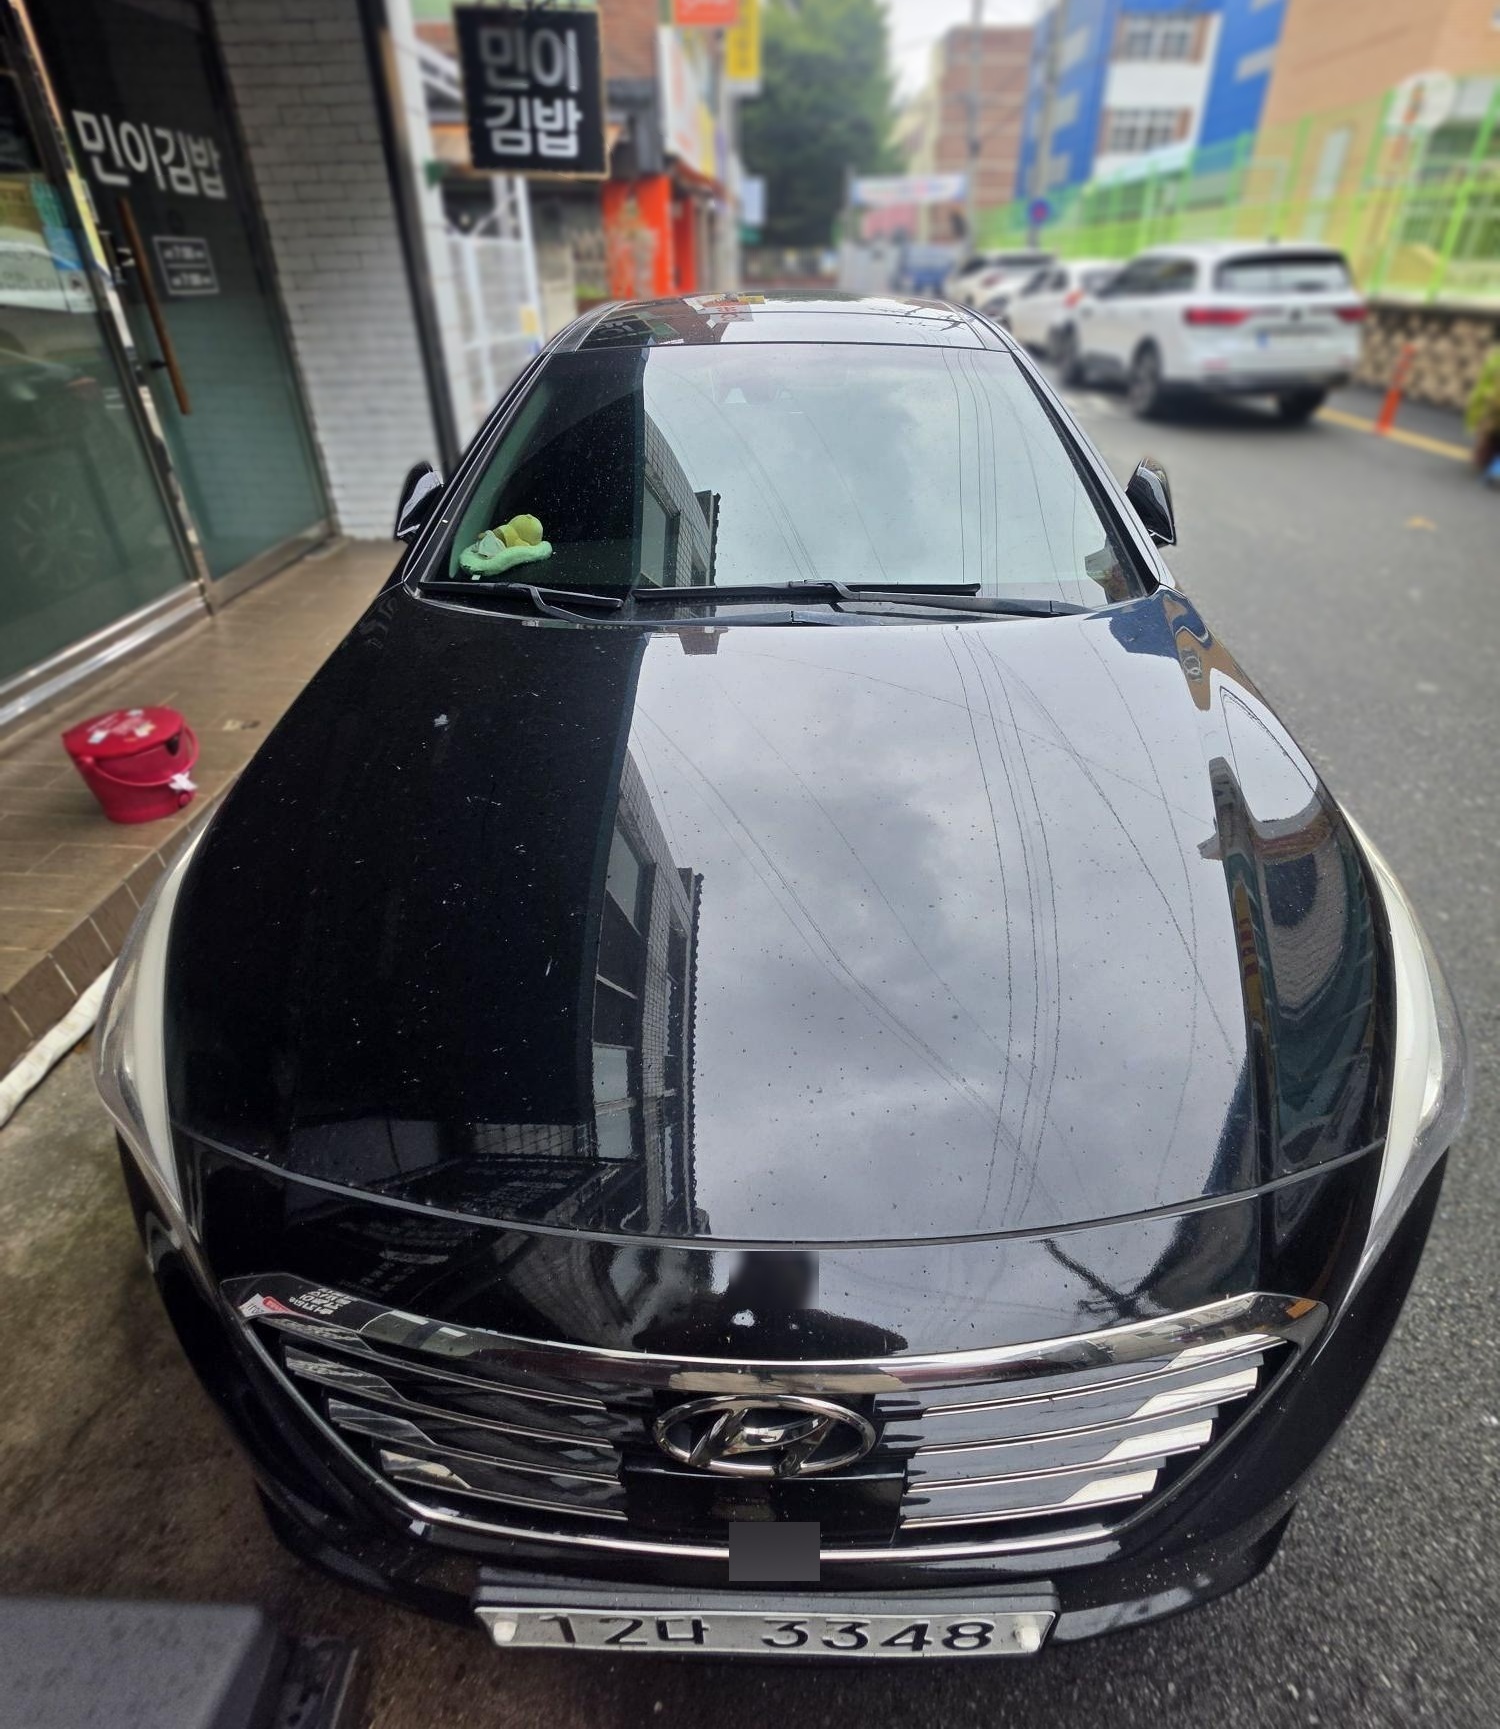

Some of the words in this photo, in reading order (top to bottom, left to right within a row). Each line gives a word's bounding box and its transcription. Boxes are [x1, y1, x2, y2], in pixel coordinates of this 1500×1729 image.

[480, 27, 580, 92] 민이
[72, 109, 227, 199] 민이김밥
[484, 96, 583, 158] 김밥
[760, 1616, 995, 1653] 3348
